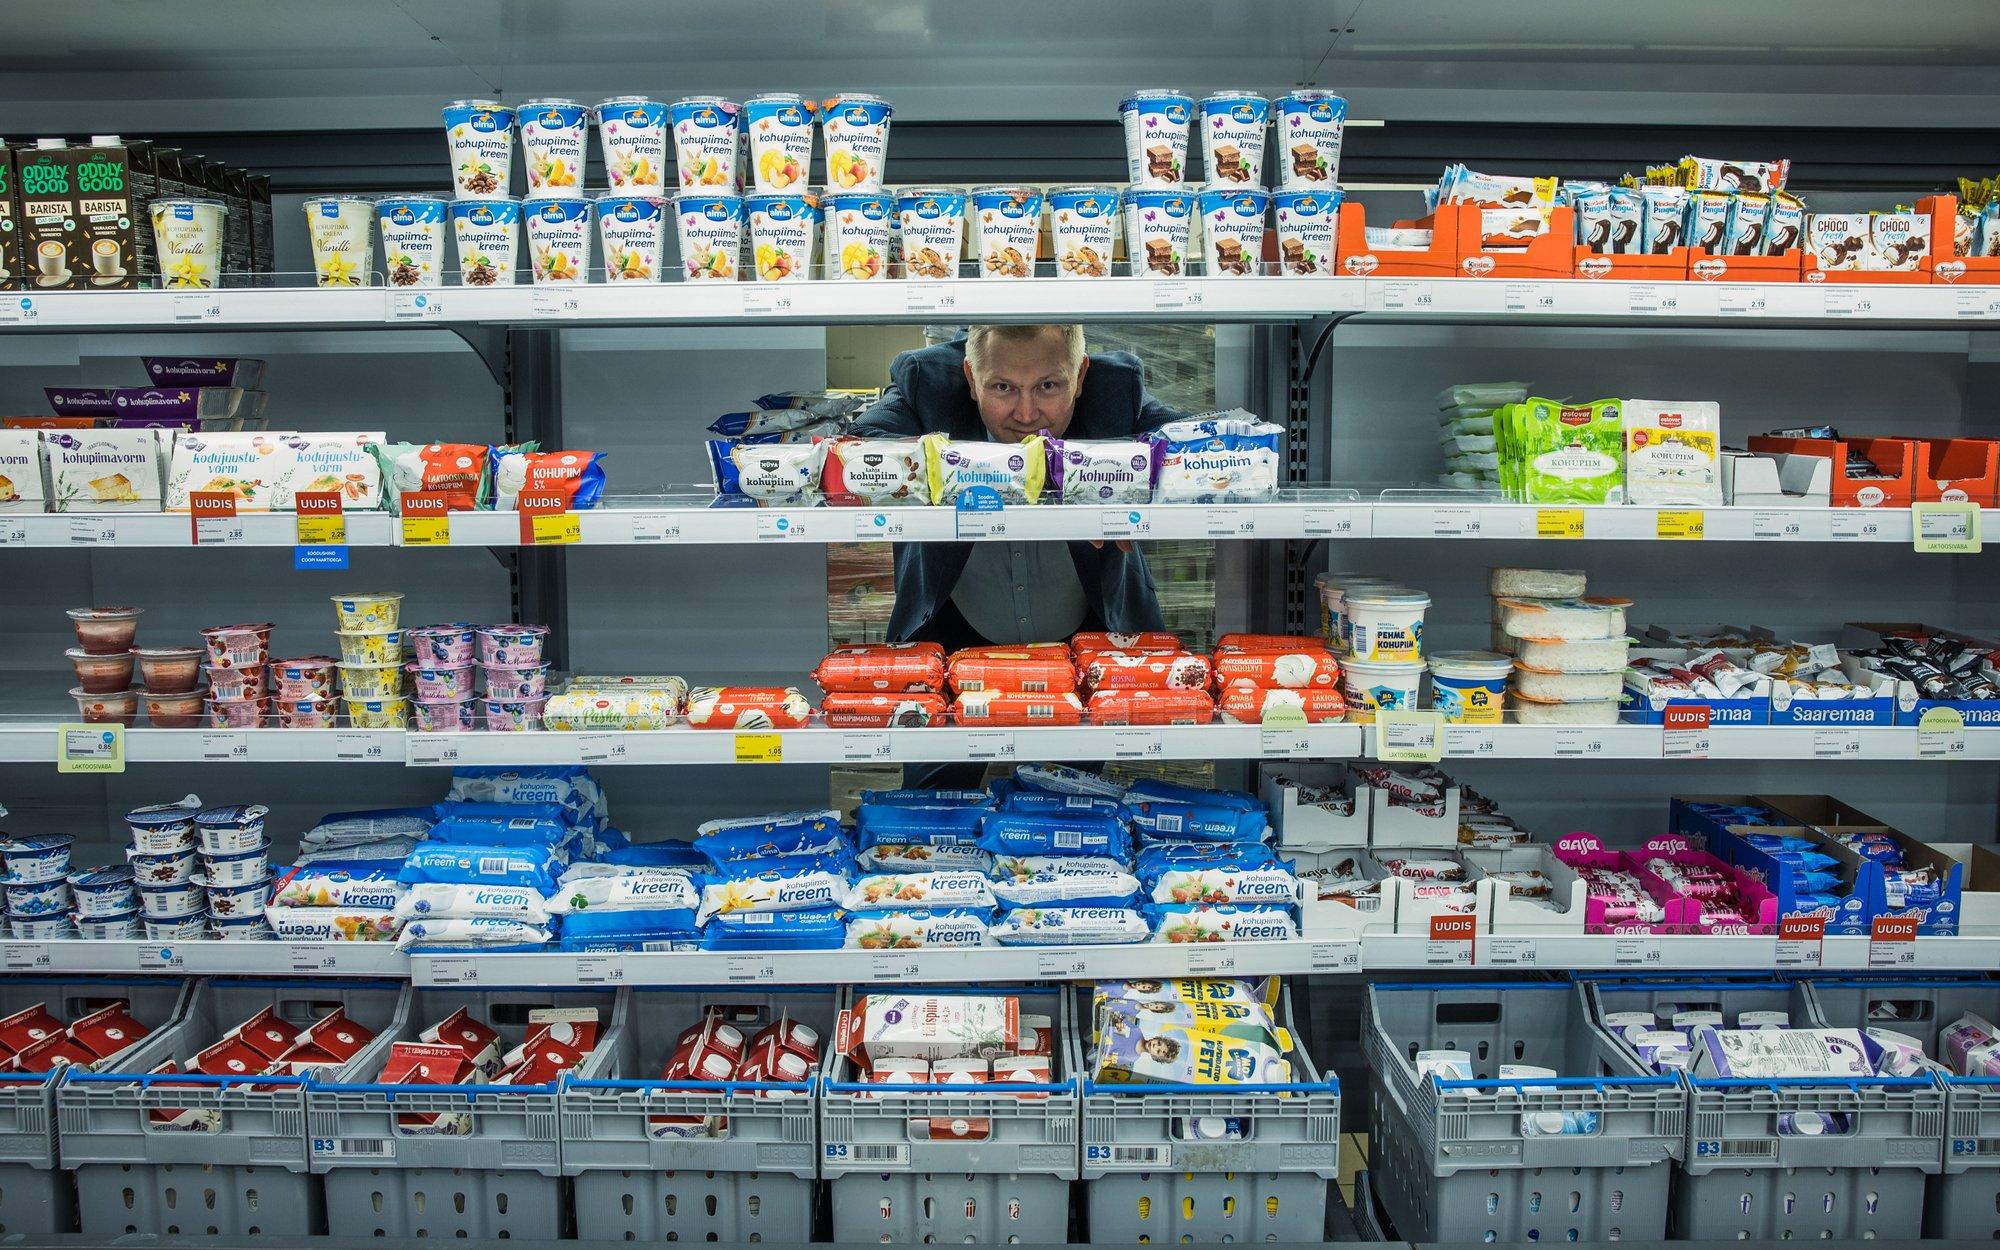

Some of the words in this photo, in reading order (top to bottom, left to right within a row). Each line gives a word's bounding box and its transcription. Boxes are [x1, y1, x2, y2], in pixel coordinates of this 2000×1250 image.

[627, 116, 648, 125] alma
[695, 115, 716, 124] alma
[847, 114, 869, 123] alma
[1311, 111, 1332, 120] alma
[473, 120, 494, 129] alma
[680, 134, 732, 145] kohupiima-
[829, 133, 882, 144] kohupiima-
[1290, 129, 1341, 140] kohupiima-
[455, 139, 509, 150] kohupiima-
[608, 136, 661, 146] kohupiima-
[1316, 139, 1340, 149] kreem
[480, 148, 508, 159] kreem
[634, 145, 661, 155] kreem
[703, 144, 732, 155] kreem
[852, 143, 881, 153] kreem
[25, 178, 69, 194] GOOD
[79, 177, 123, 192] GOOD
[30, 203, 69, 215] BARISTA
[84, 201, 123, 213] BARISTA
[1059, 225, 1111, 236] kohupiima-
[1817, 220, 1848, 232] CHOCO
[1879, 220, 1910, 232] CHOCO
[457, 233, 510, 243] kohupiima-
[1083, 234, 1110, 245] kreem
[1821, 230, 1844, 241] fresh
[1883, 230, 1906, 241] fresh
[168, 241, 205, 257] Vanilli
[316, 239, 350, 253] Vanilli
[478, 242, 510, 252] kreem
[1468, 260, 1490, 269] Kinder
[1585, 261, 1607, 269] Kinder
[165, 366, 216, 375] kohupiimavorm
[62, 452, 146, 466] kohupiimavorm
[192, 451, 260, 466] kodujuustu-
[297, 451, 365, 464] kodujuustu-
[1650, 452, 1694, 461] KOHUPIIM
[312, 463, 343, 473] vorm
[1183, 455, 1251, 471] kohupiim
[1551, 458, 1601, 467] KOHUPIIM
[208, 465, 238, 475] vorm
[533, 467, 581, 479] KOHUPIIM
[850, 471, 898, 482] kohupiim
[957, 471, 1011, 485] kohupiim
[1079, 469, 1134, 484] kohupiim
[427, 481, 463, 491] KOHUPIIM
[533, 480, 546, 490] 5%
[746, 477, 794, 488] kohupiim
[195, 499, 233, 509] UUDIS
[300, 499, 338, 509] UUDIS
[406, 498, 444, 509] UUDIS
[524, 497, 561, 508] UUDIS
[1135, 523, 1150, 531] 1.15
[101, 531, 115, 539] 2.39
[331, 531, 346, 539] 2.29
[1377, 631, 1405, 640] PEHME
[1377, 640, 1414, 649] KOHUPIIM
[1110, 675, 1136, 683] ROSINA
[832, 715, 881, 723] KOHUPIIMAPASTA
[1669, 712, 1706, 723] UUDIS
[1792, 706, 1875, 722] Saaremaa
[512, 789, 558, 802] kreem
[424, 856, 456, 868] kreem
[632, 880, 684, 894] kreem
[786, 879, 830, 889] kohupiima-
[1237, 881, 1289, 896] kreem
[352, 885, 396, 896] kohupiima-
[778, 886, 831, 903] kreem
[343, 892, 396, 906] kreem
[475, 890, 529, 906] kreem
[1233, 924, 1287, 938] kreem
[1435, 921, 1472, 931] UUDIS
[1784, 924, 1820, 934] UUDIS
[1877, 925, 1913, 935] UUDIS
[926, 929, 981, 942] kreem
[922, 998, 938, 1037] täispiim
[1197, 1038, 1215, 1078] PETT
[826, 1145, 848, 1157] B3
[1087, 1146, 1111, 1159] B3
[1697, 1142, 1720, 1155] B3
